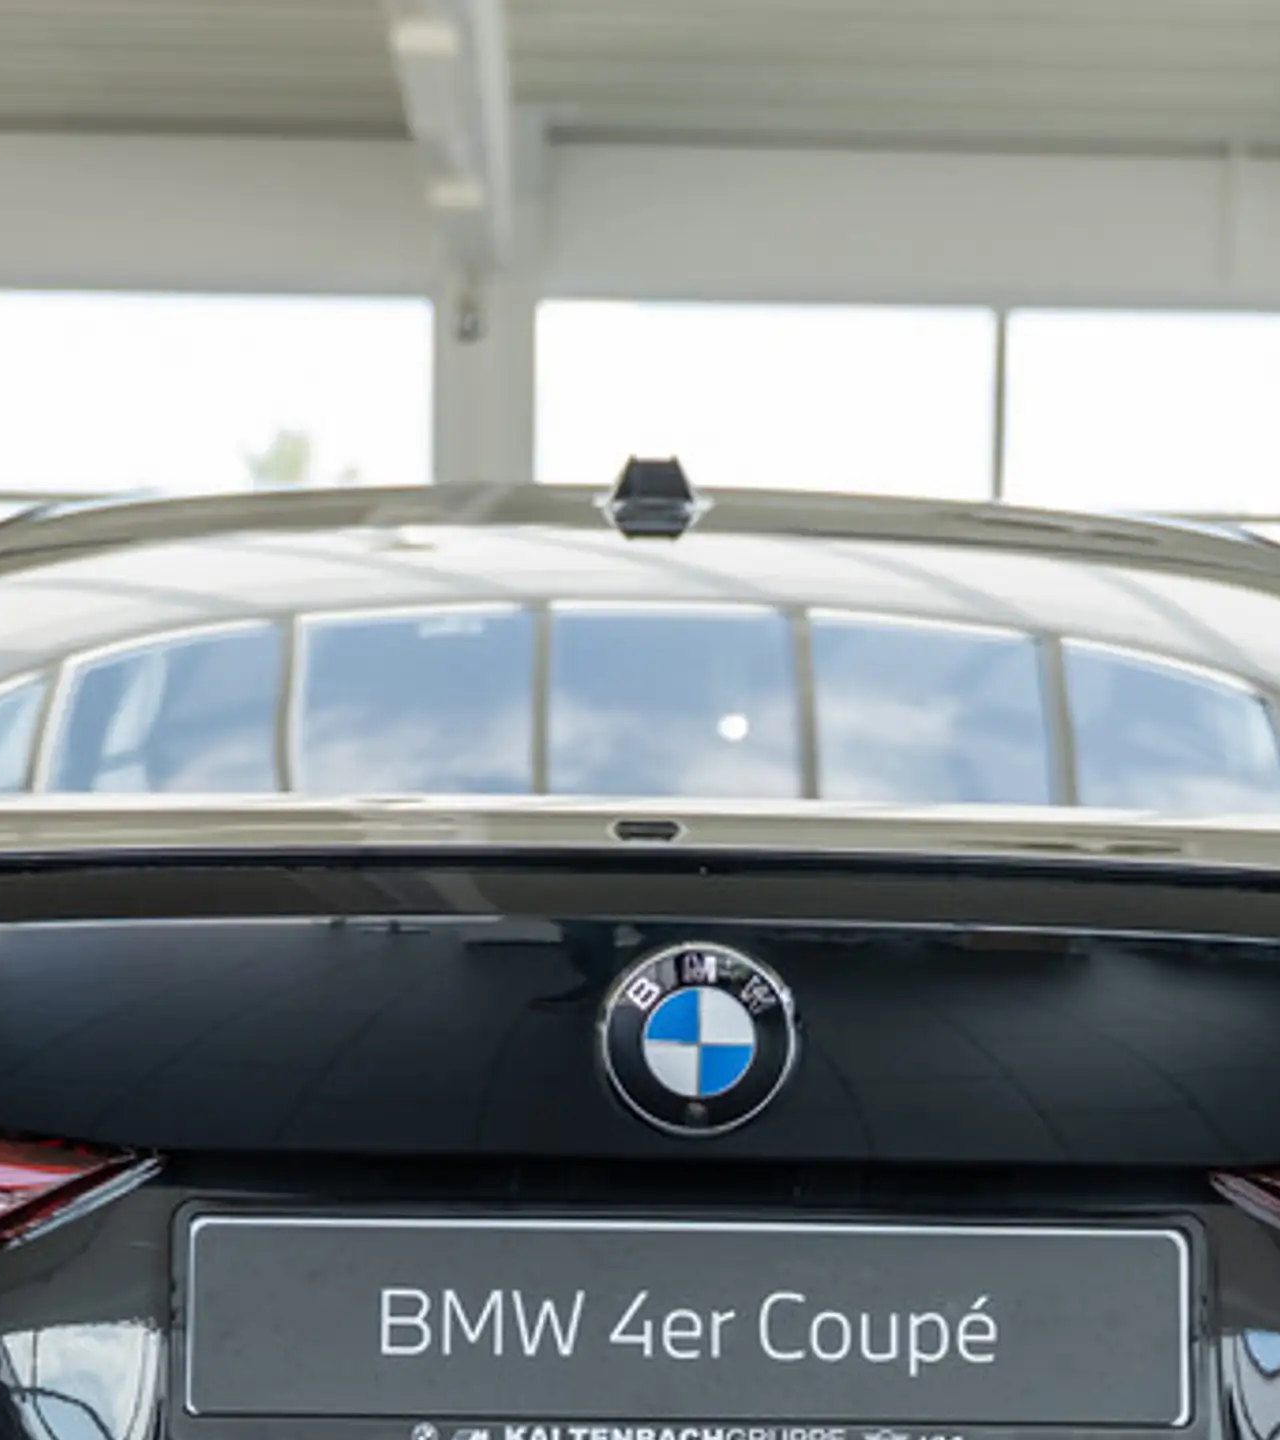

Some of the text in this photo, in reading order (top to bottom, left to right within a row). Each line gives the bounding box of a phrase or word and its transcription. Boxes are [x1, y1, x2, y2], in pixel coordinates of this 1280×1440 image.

[625, 957, 776, 1015] BMW
[380, 1288, 998, 1378] BMW 4er Coupé
